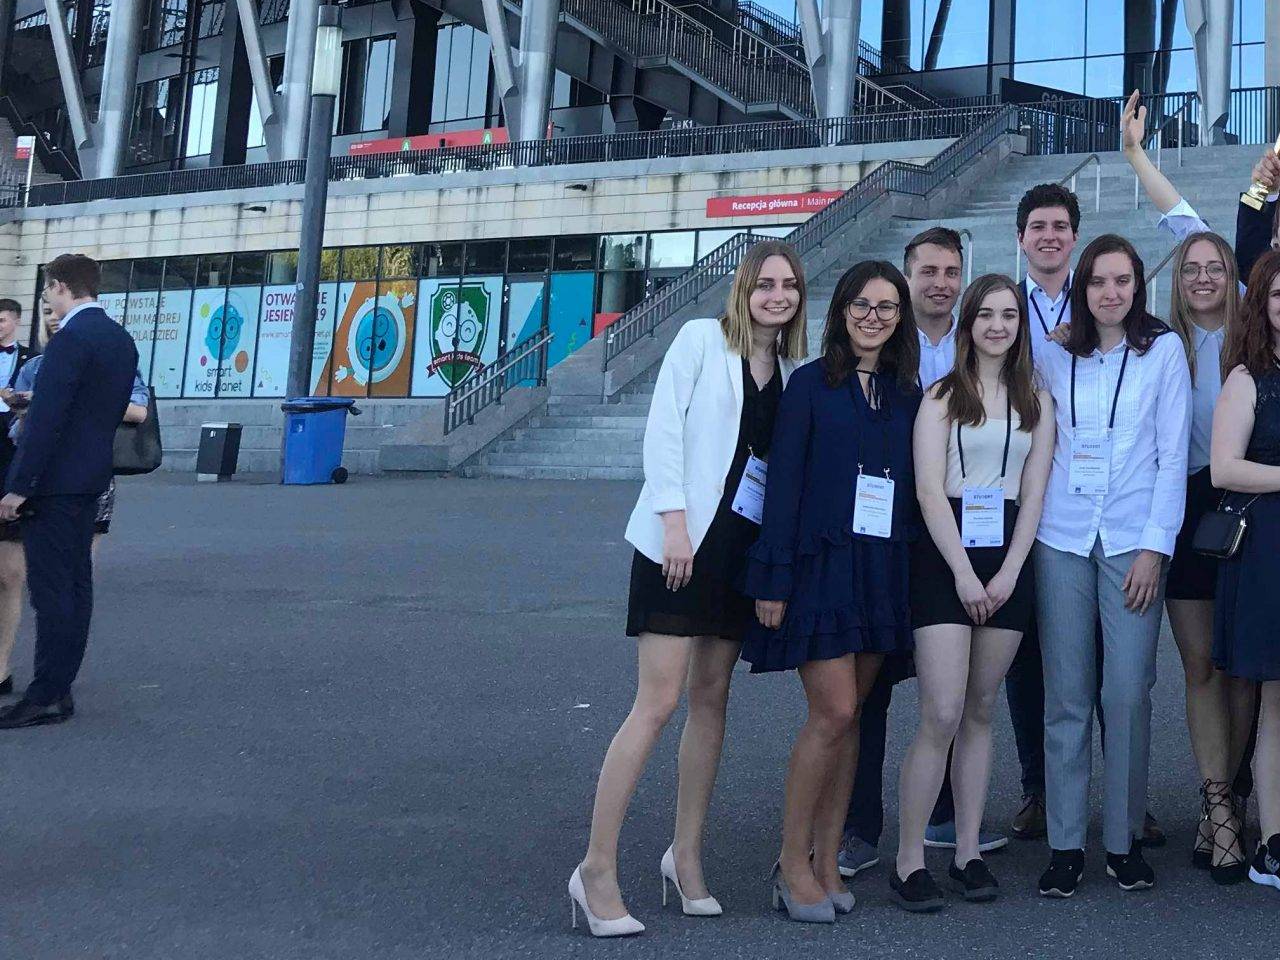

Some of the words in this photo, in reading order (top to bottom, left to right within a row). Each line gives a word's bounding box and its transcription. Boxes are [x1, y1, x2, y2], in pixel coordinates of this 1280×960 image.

[732, 201, 767, 212] Recepcja
[768, 199, 798, 211] główna
[807, 197, 826, 206] Main
[195, 380, 213, 392] kids
